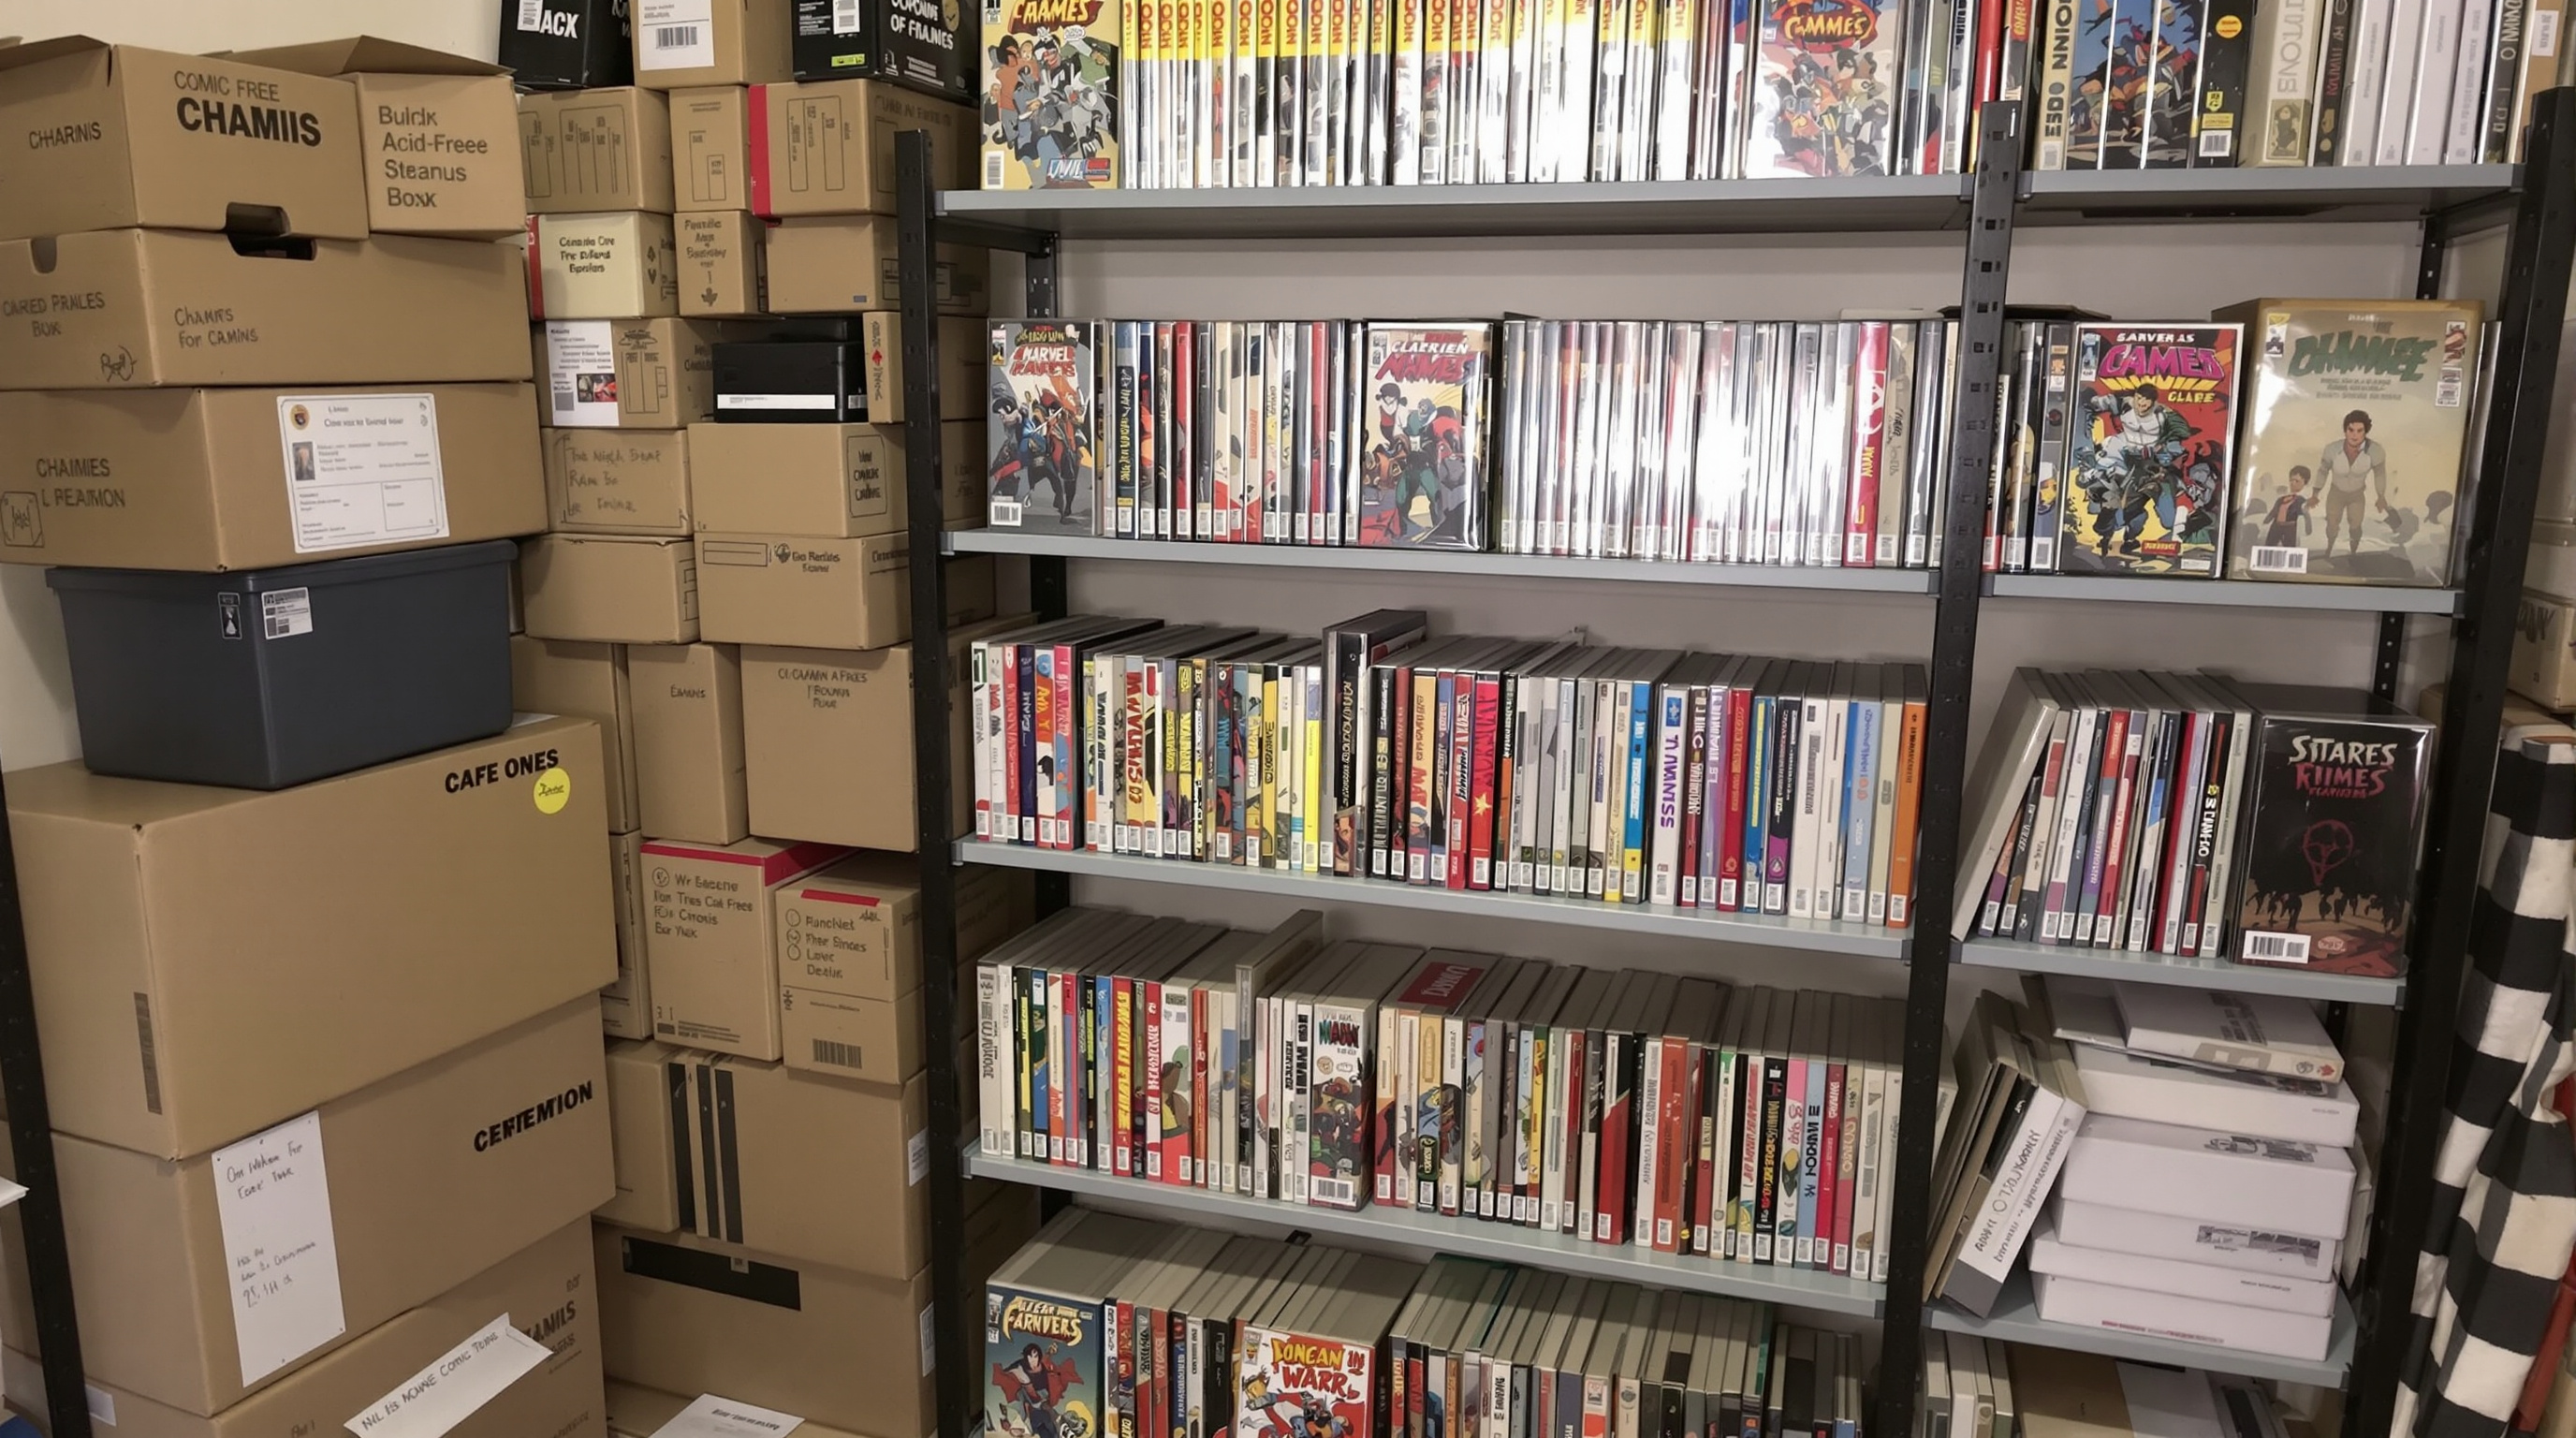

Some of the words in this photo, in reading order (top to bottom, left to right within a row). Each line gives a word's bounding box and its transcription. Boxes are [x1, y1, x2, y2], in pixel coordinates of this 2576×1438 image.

[174, 71, 230, 96] COMIC
[236, 80, 280, 102] FREE
[445, 762, 499, 794] CAFE
[505, 749, 559, 778] ONES
